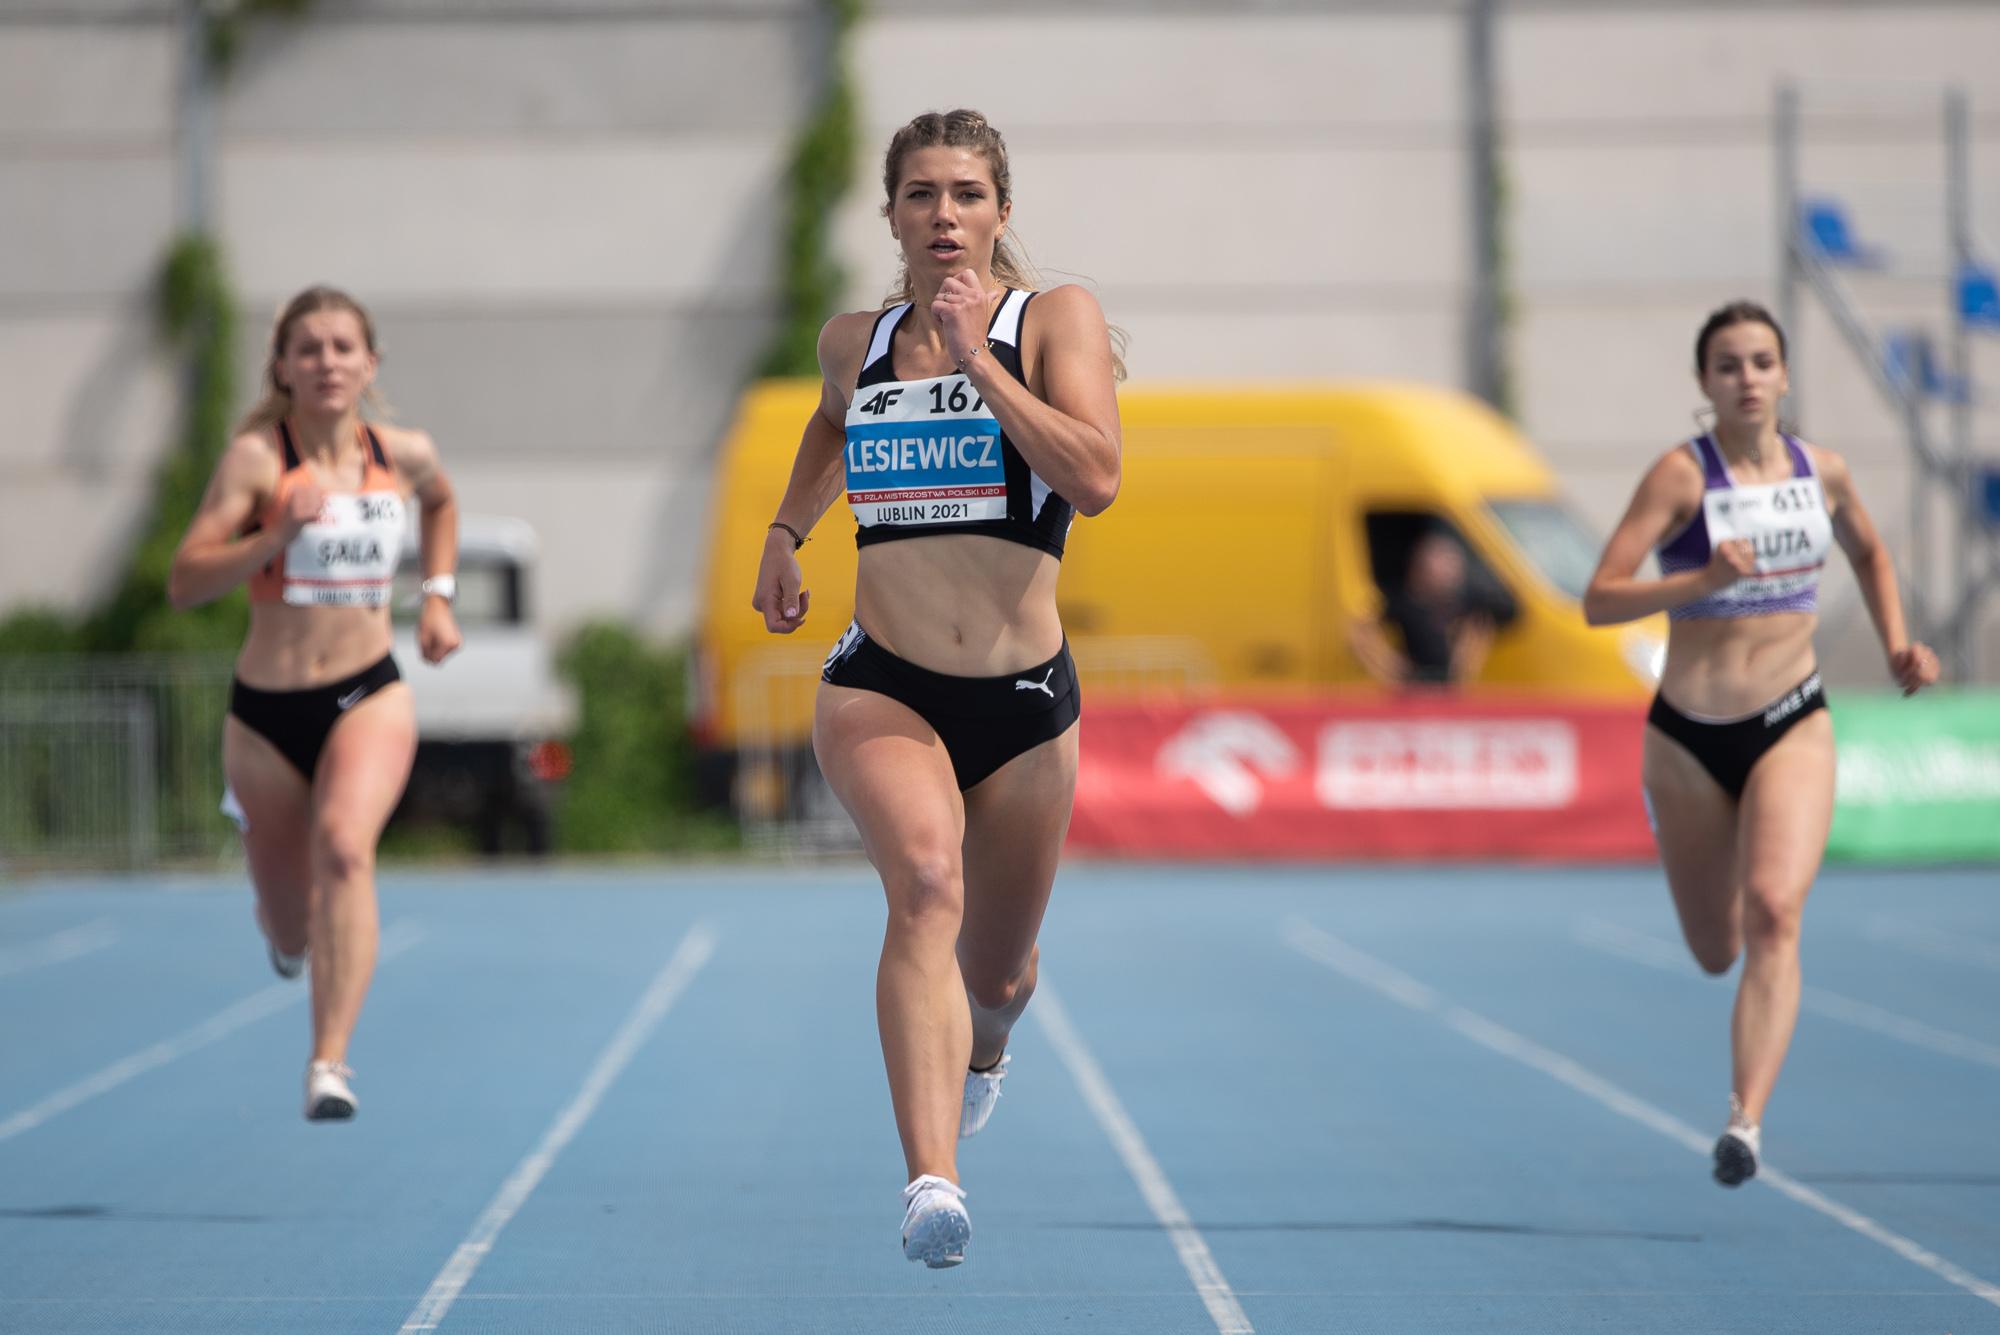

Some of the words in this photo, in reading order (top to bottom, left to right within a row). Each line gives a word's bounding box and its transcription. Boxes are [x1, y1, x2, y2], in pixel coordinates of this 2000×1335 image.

[860, 388, 904, 415] 4F
[848, 435, 998, 473] LESIEWICZ
[853, 494, 863, 502] 75.
[884, 491, 946, 500] MISTRZOSTWA
[948, 489, 979, 497] POLSKI
[981, 488, 1000, 496] U20
[877, 506, 925, 522] LUBLIN
[931, 503, 968, 519] 2021
[1749, 528, 1812, 558] LUTA
